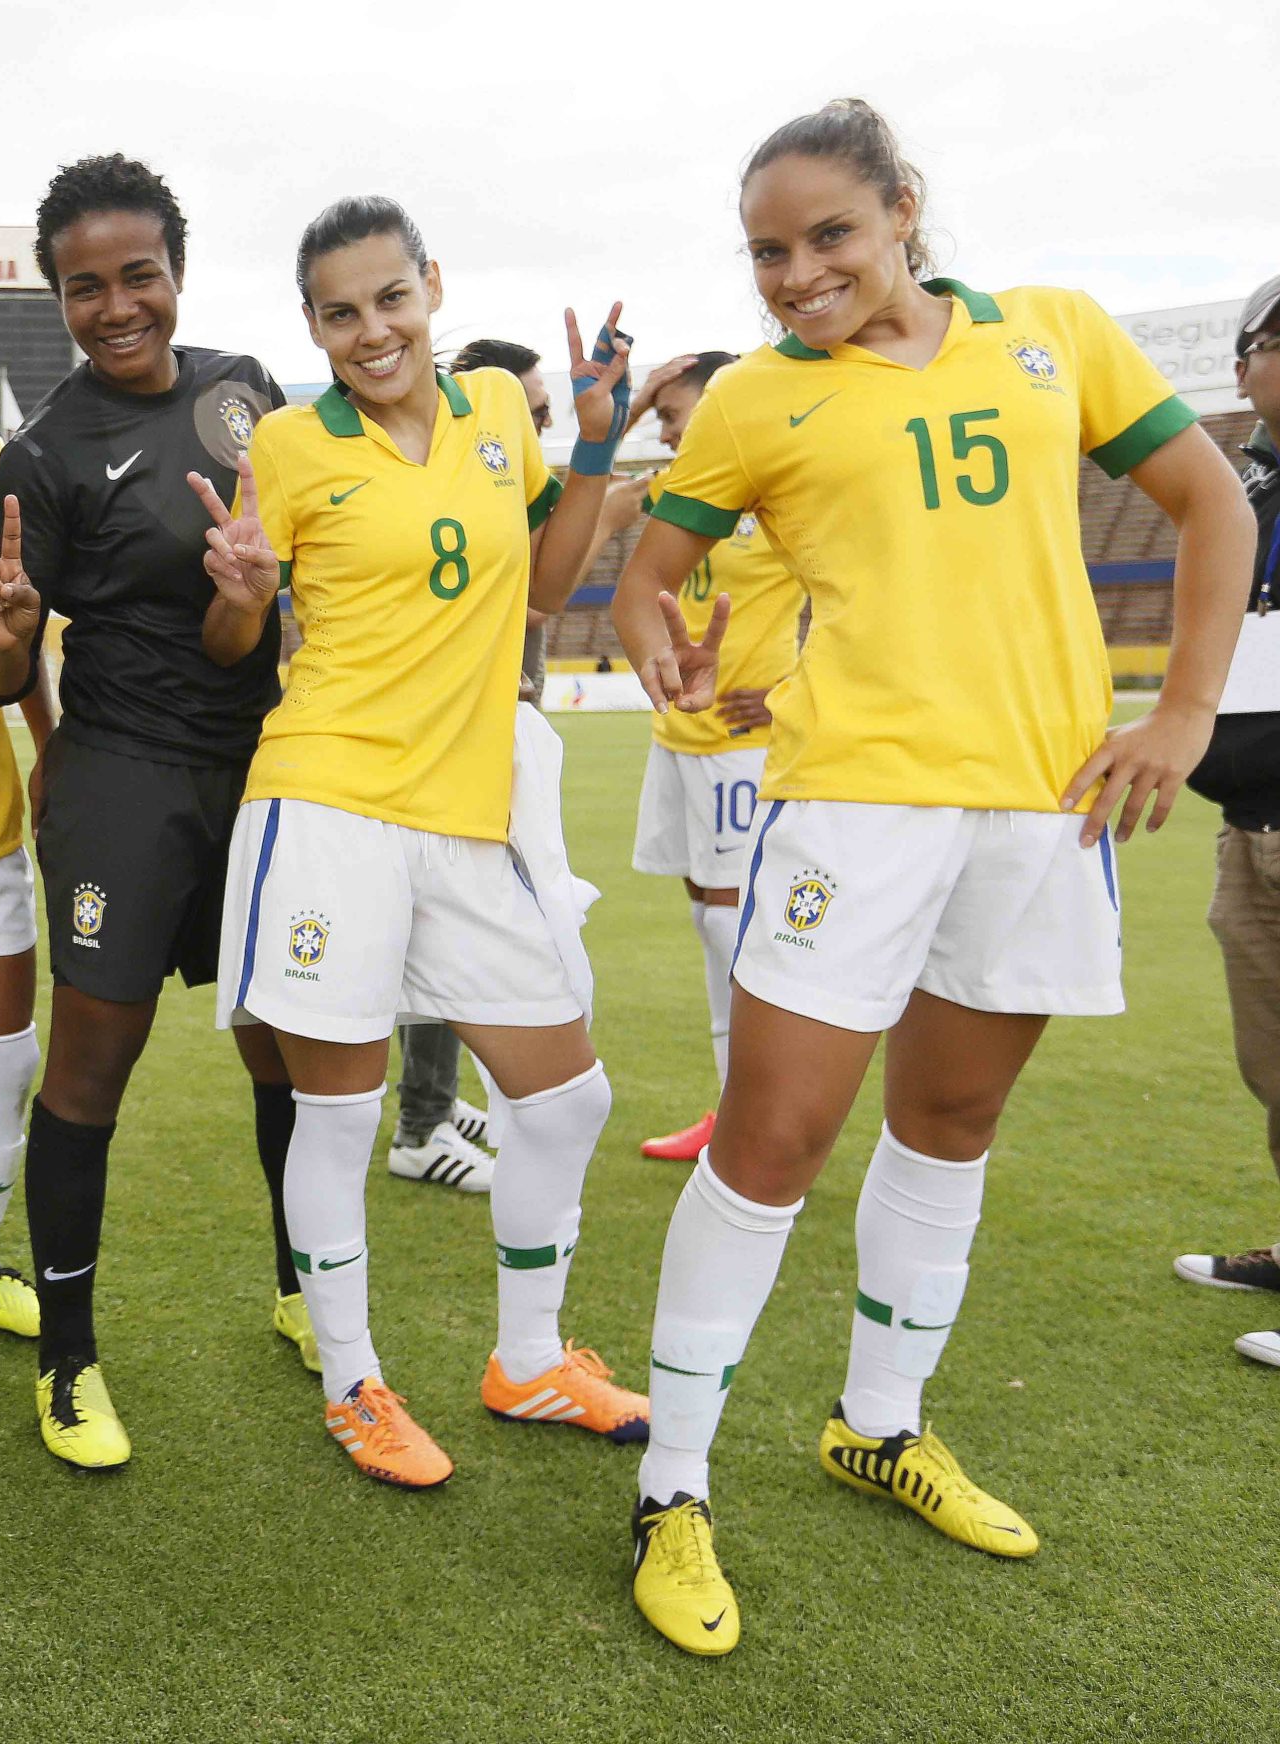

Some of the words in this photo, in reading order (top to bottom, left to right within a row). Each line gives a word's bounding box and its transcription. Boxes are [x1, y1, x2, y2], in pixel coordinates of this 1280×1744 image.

[1131, 317, 1237, 349] Segu
[1030, 382, 1066, 396] BRASIL
[905, 408, 1009, 510] 15
[494, 478, 517, 488] BRASIL
[429, 518, 470, 600] 8
[714, 780, 758, 833] 10
[72, 935, 101, 948] BRASIL
[773, 931, 816, 950] BRASIL
[284, 968, 321, 981] BRASIL
